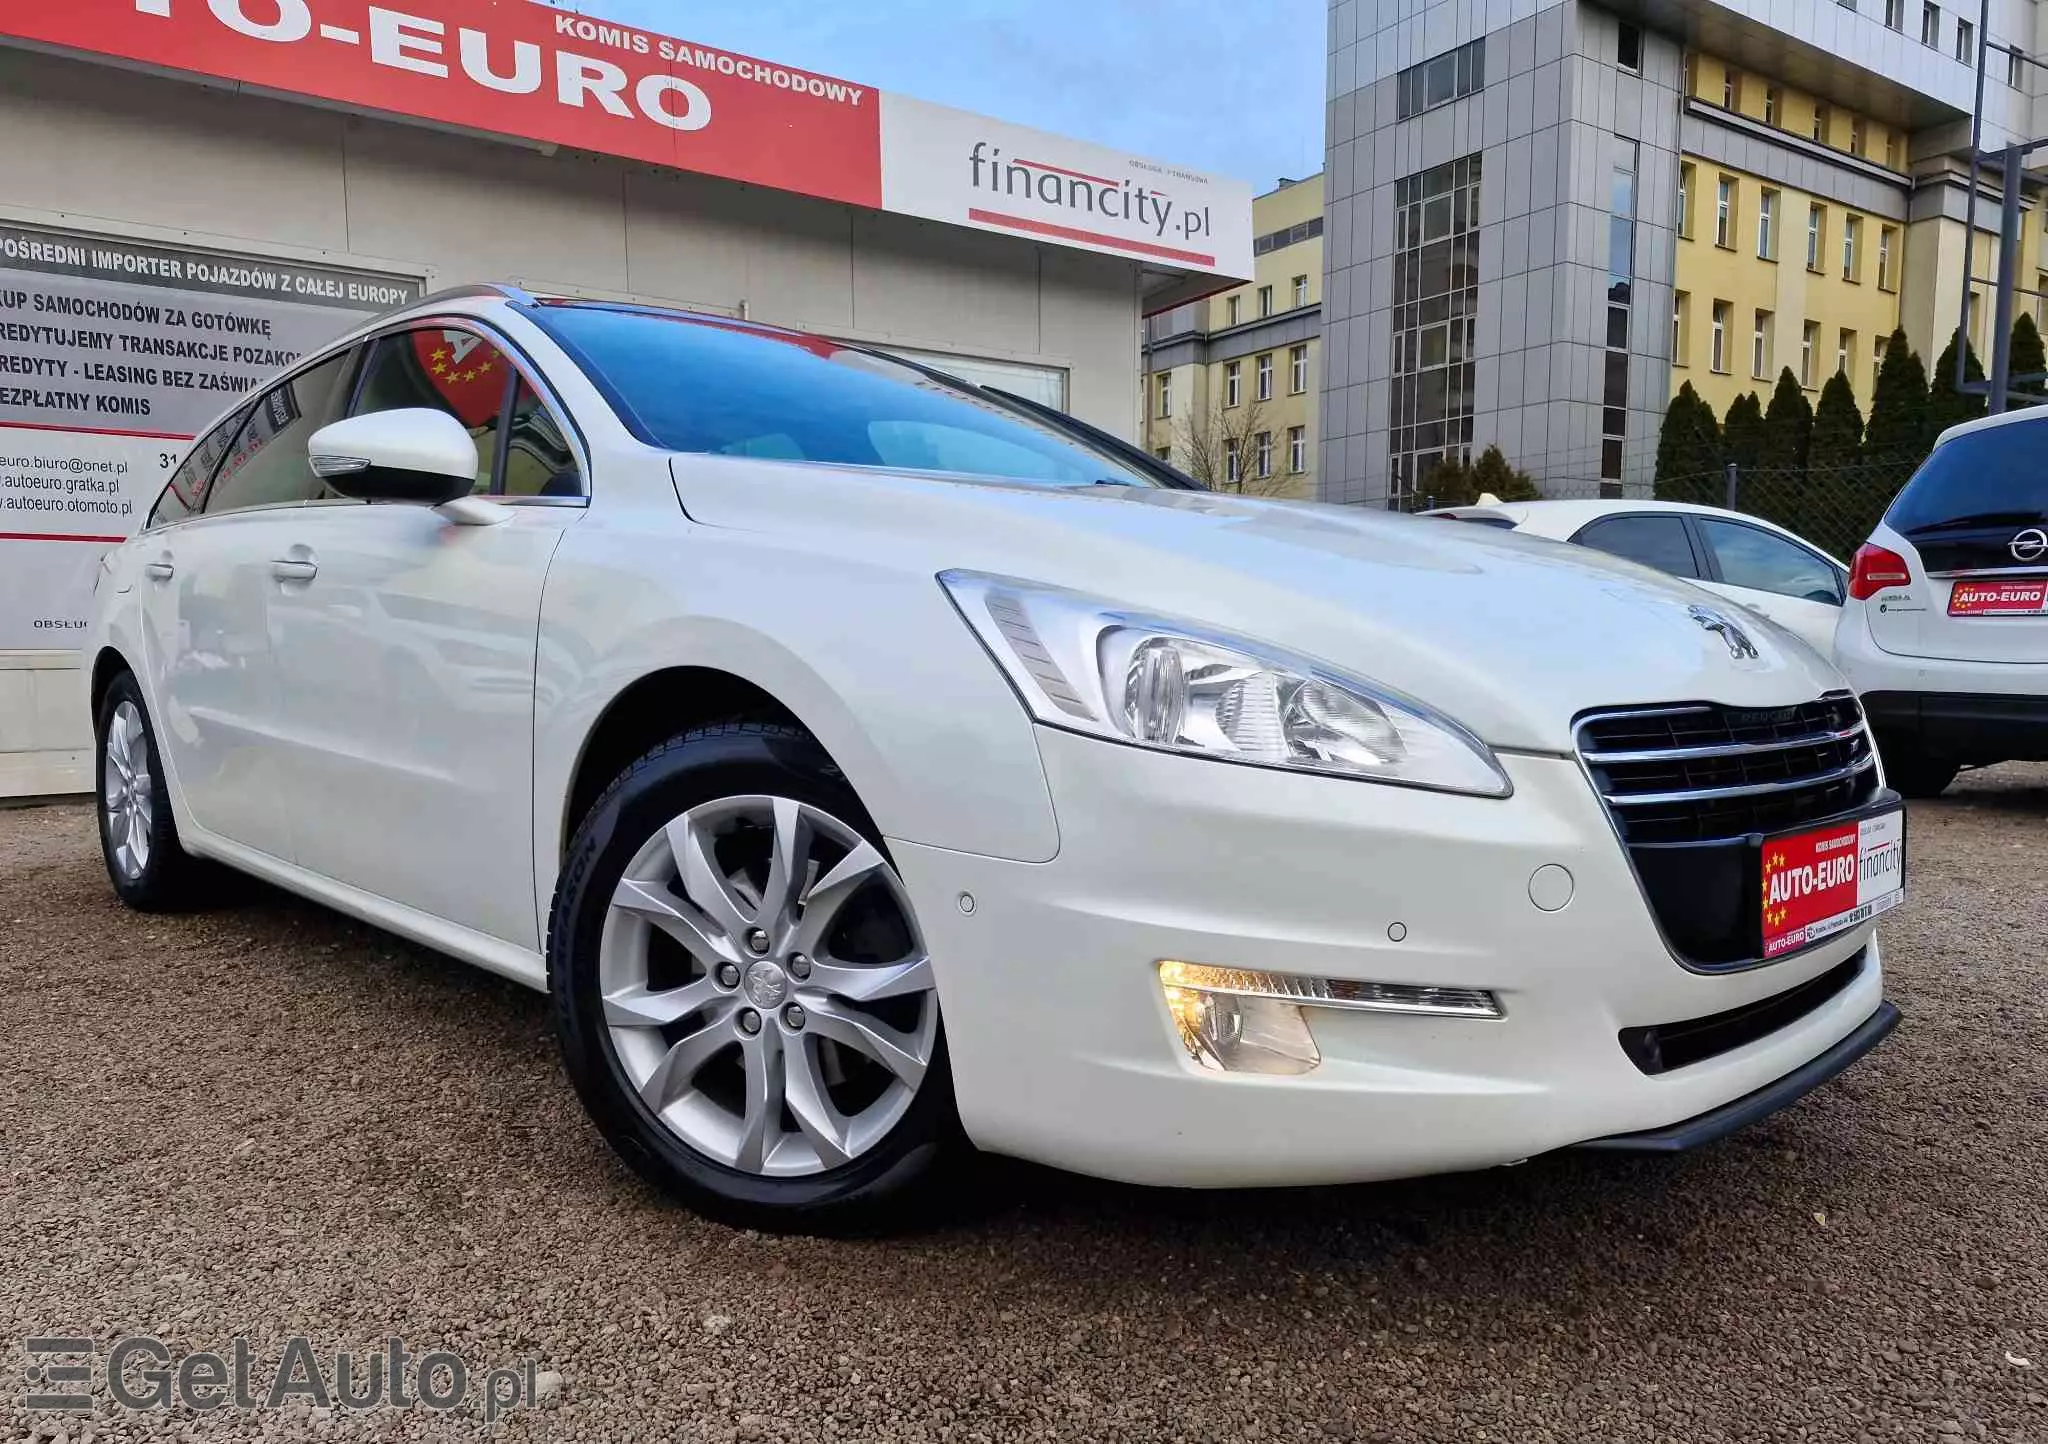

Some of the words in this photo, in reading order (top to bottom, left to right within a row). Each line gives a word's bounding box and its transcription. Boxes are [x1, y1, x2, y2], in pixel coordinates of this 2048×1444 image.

[136, 0, 712, 132] O-EURO
[555, 14, 650, 54] KOMIS
[658, 40, 864, 106] SAMOCHODOWY
[968, 141, 1211, 241] financity.pl
[92, 250, 183, 280] IMPORTER
[186, 262, 277, 290] POJAZDÓW
[280, 275, 292, 292] Z
[295, 276, 344, 298] CAŁEJ
[348, 283, 408, 306] EUROPY
[33, 293, 161, 325] SAMOCHODÓW
[164, 308, 187, 327] ZA
[191, 311, 272, 342] GOTÓWKĘ
[119, 334, 229, 362] TRANSAKCJE
[84, 362, 157, 386] LEASING
[162, 369, 196, 389] BEZ
[198, 371, 264, 393] ZAŚWIA
[96, 394, 151, 416] KOMIS
[1960, 591, 2040, 602] AUTO-EURO
[1769, 854, 1855, 905] AUTO-EURO
[1768, 932, 1805, 952] AUTO-EURO
